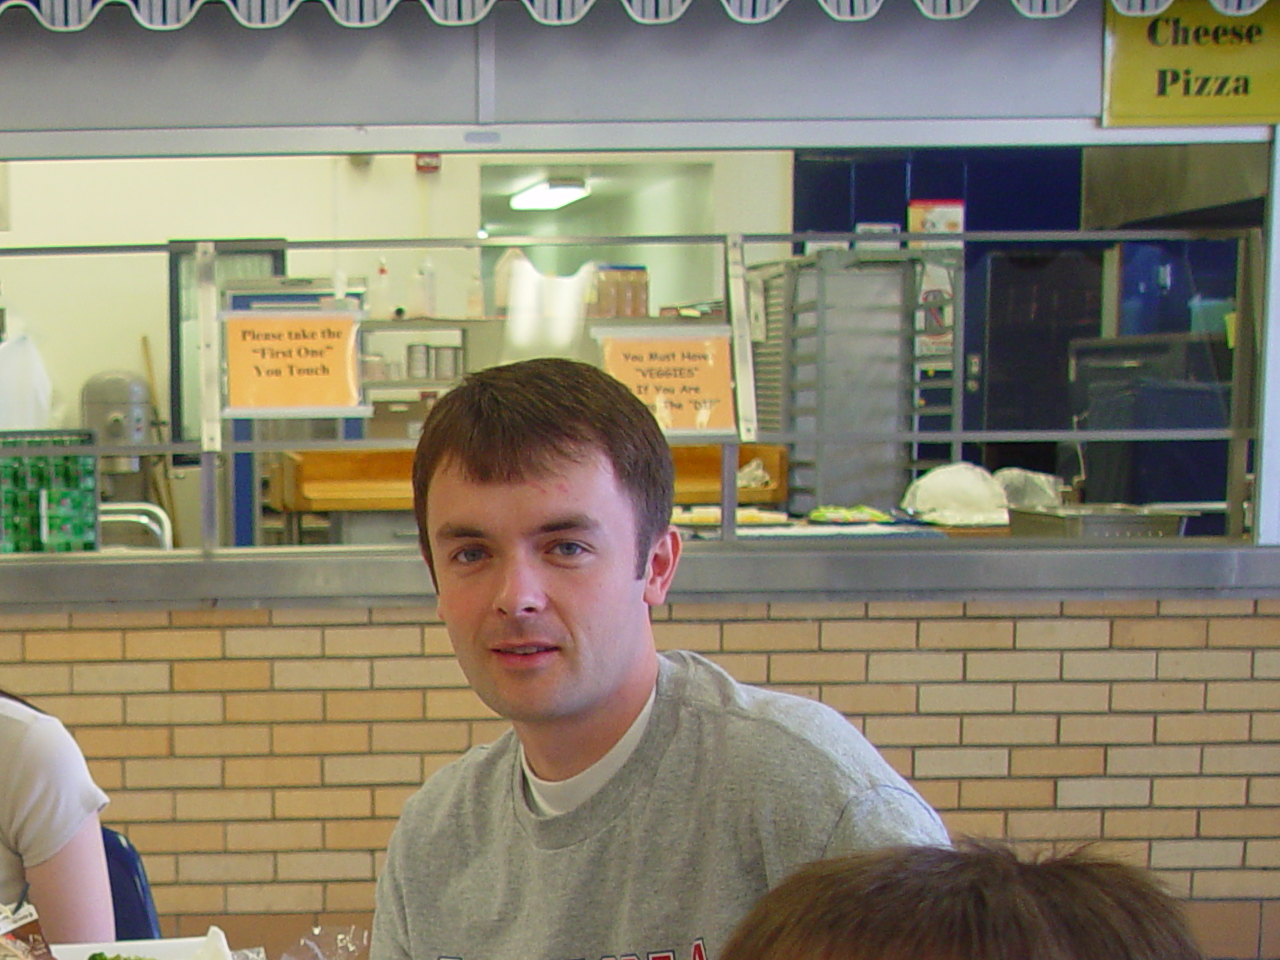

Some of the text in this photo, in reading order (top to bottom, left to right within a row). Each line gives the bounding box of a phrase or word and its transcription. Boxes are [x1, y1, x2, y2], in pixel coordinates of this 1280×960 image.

[1147, 17, 1263, 46] Cheese
[1156, 69, 1250, 97] Pizza
[241, 328, 343, 341] Please take the
[649, 352, 676, 361] Must
[254, 364, 330, 377] You Touch
[680, 385, 700, 394] Are
